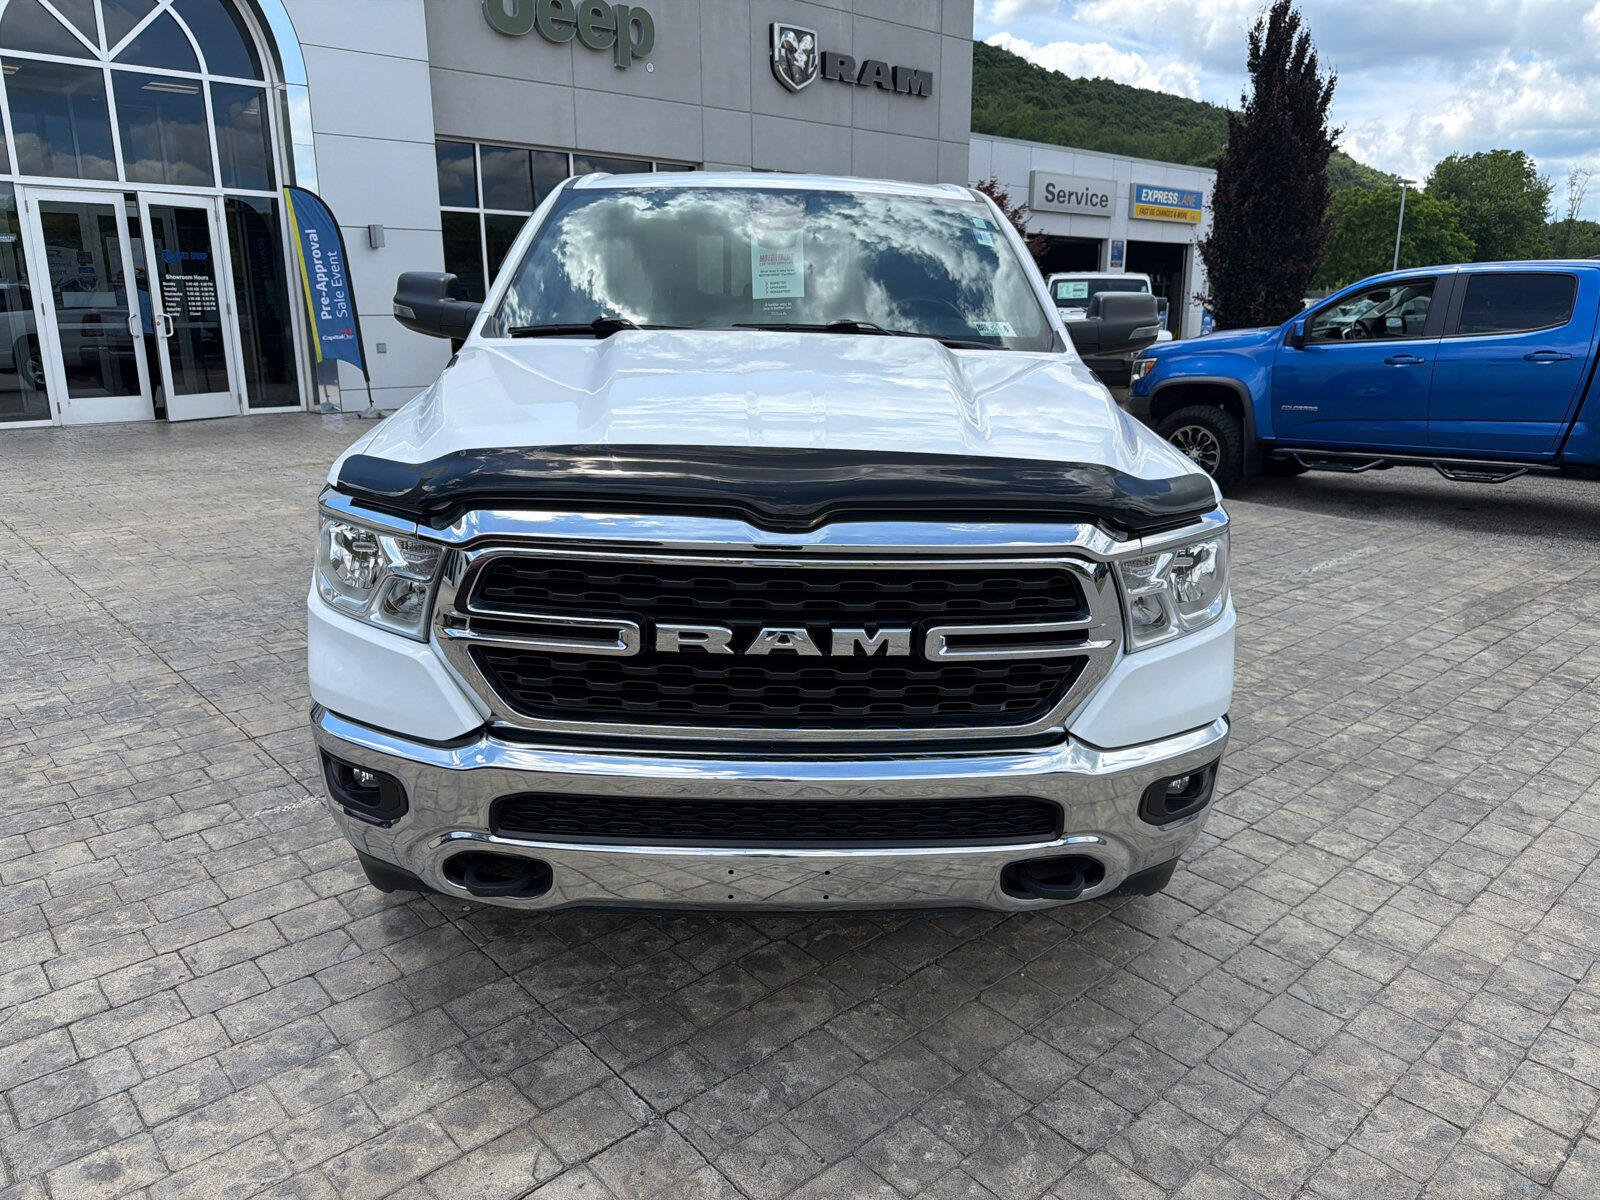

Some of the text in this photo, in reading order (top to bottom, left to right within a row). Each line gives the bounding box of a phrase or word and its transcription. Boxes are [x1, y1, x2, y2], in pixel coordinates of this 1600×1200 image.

[821, 51, 933, 97] RAM
[1045, 183, 1109, 208] Service
[305, 229, 332, 320] Pre-Approval
[327, 251, 348, 318] Sale Event
[655, 623, 911, 656] RAM
